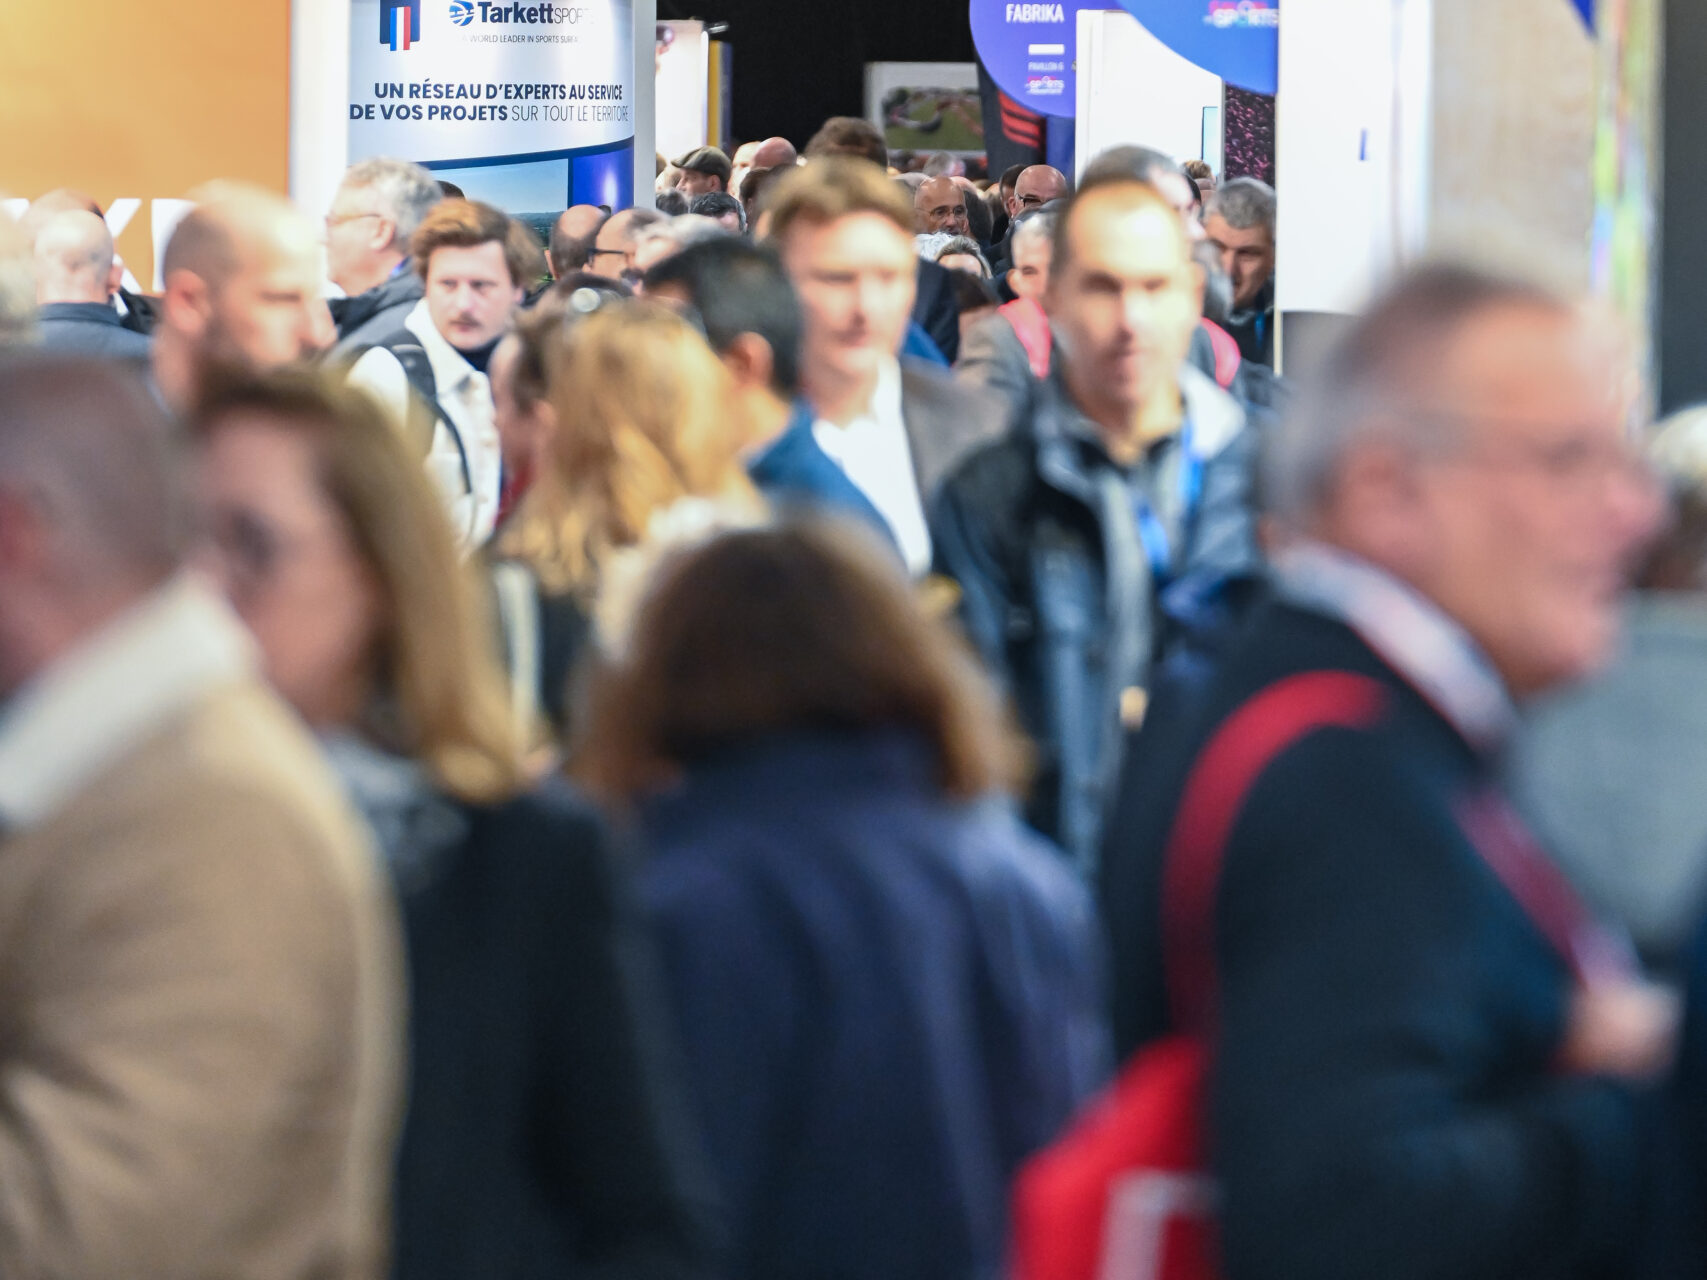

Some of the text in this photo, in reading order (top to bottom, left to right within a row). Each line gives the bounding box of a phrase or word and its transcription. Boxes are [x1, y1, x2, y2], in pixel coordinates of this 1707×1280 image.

[1006, 3, 1065, 23] FABRIKA
[500, 34, 525, 43] LEADER
[527, 34, 534, 43] IN
[535, 34, 559, 43] SPORTS
[374, 83, 403, 99] UN
[409, 78, 481, 99] RÉSEAU
[569, 84, 586, 100] AU
[588, 84, 623, 100] SERVICE
[349, 104, 375, 120] DE
[380, 104, 423, 120] VOS
[428, 105, 508, 121] PROJETS
[511, 105, 538, 121] SUR
[542, 105, 575, 121] TOUT
[577, 105, 588, 121] LE
